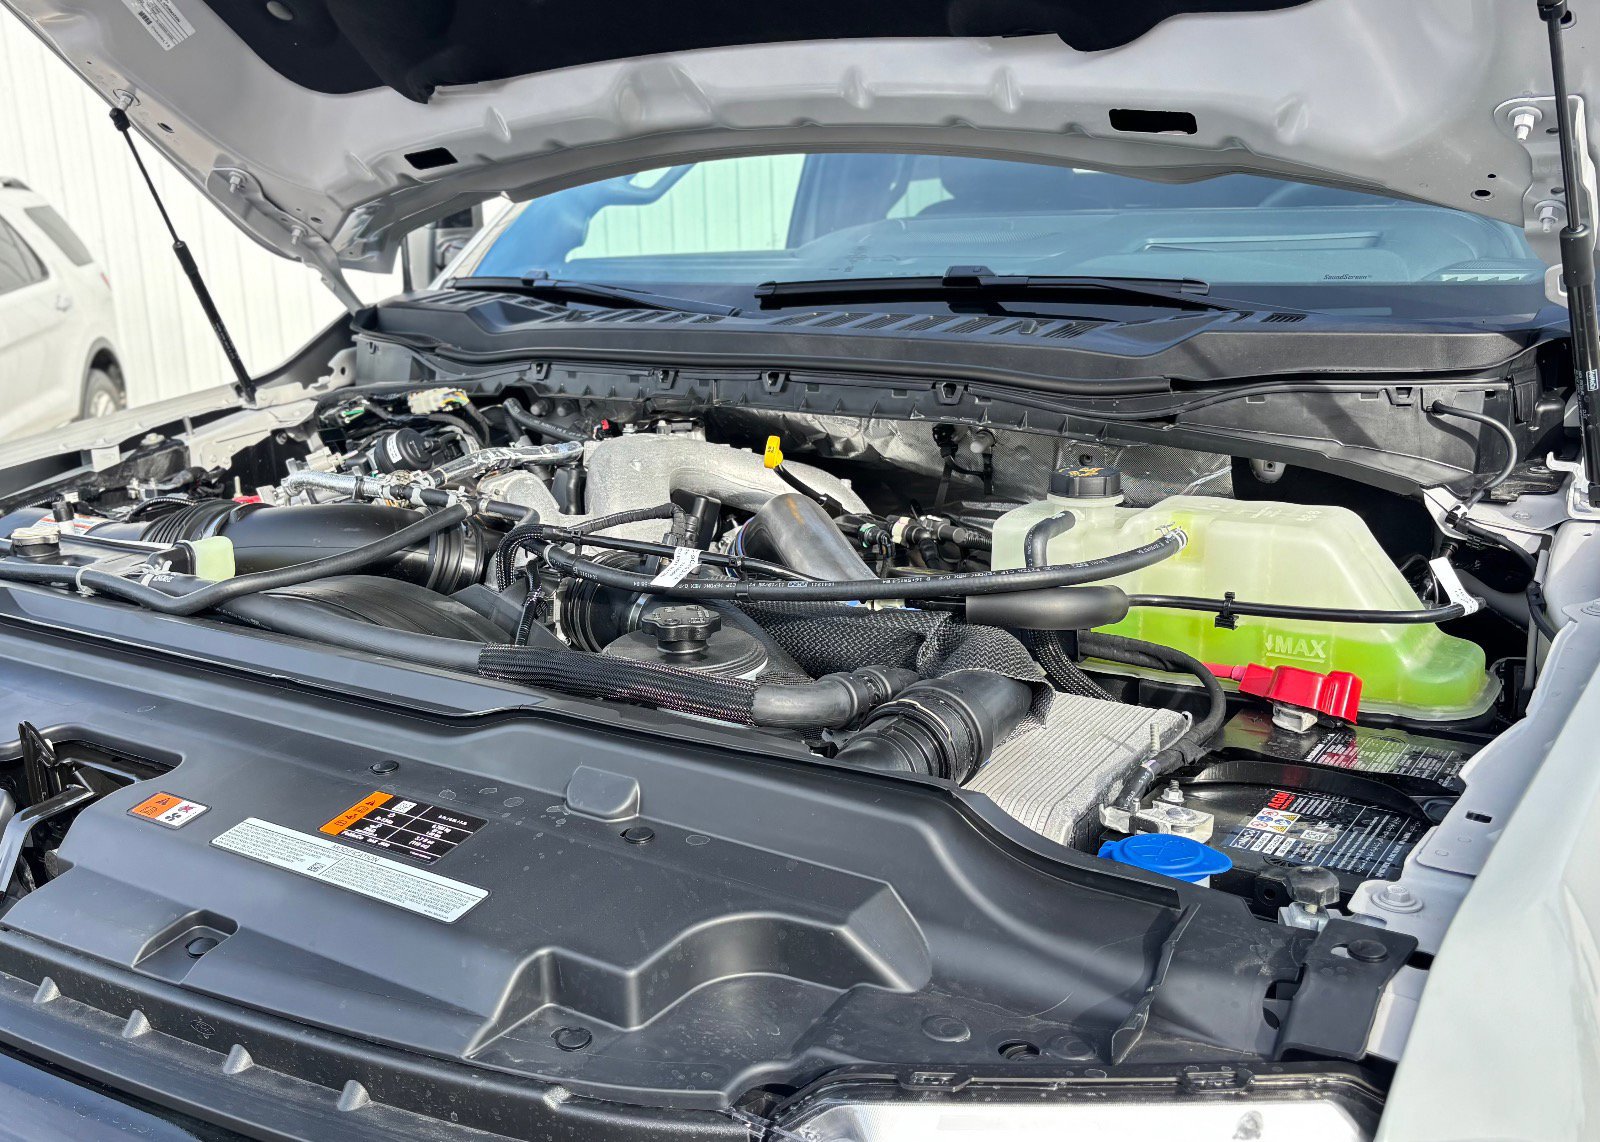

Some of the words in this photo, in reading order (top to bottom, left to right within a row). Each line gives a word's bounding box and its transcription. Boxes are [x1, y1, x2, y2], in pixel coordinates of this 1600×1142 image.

[1274, 634, 1327, 660] MAX
[1268, 792, 1290, 809] AGM
[332, 845, 381, 863] MODIFICATION
